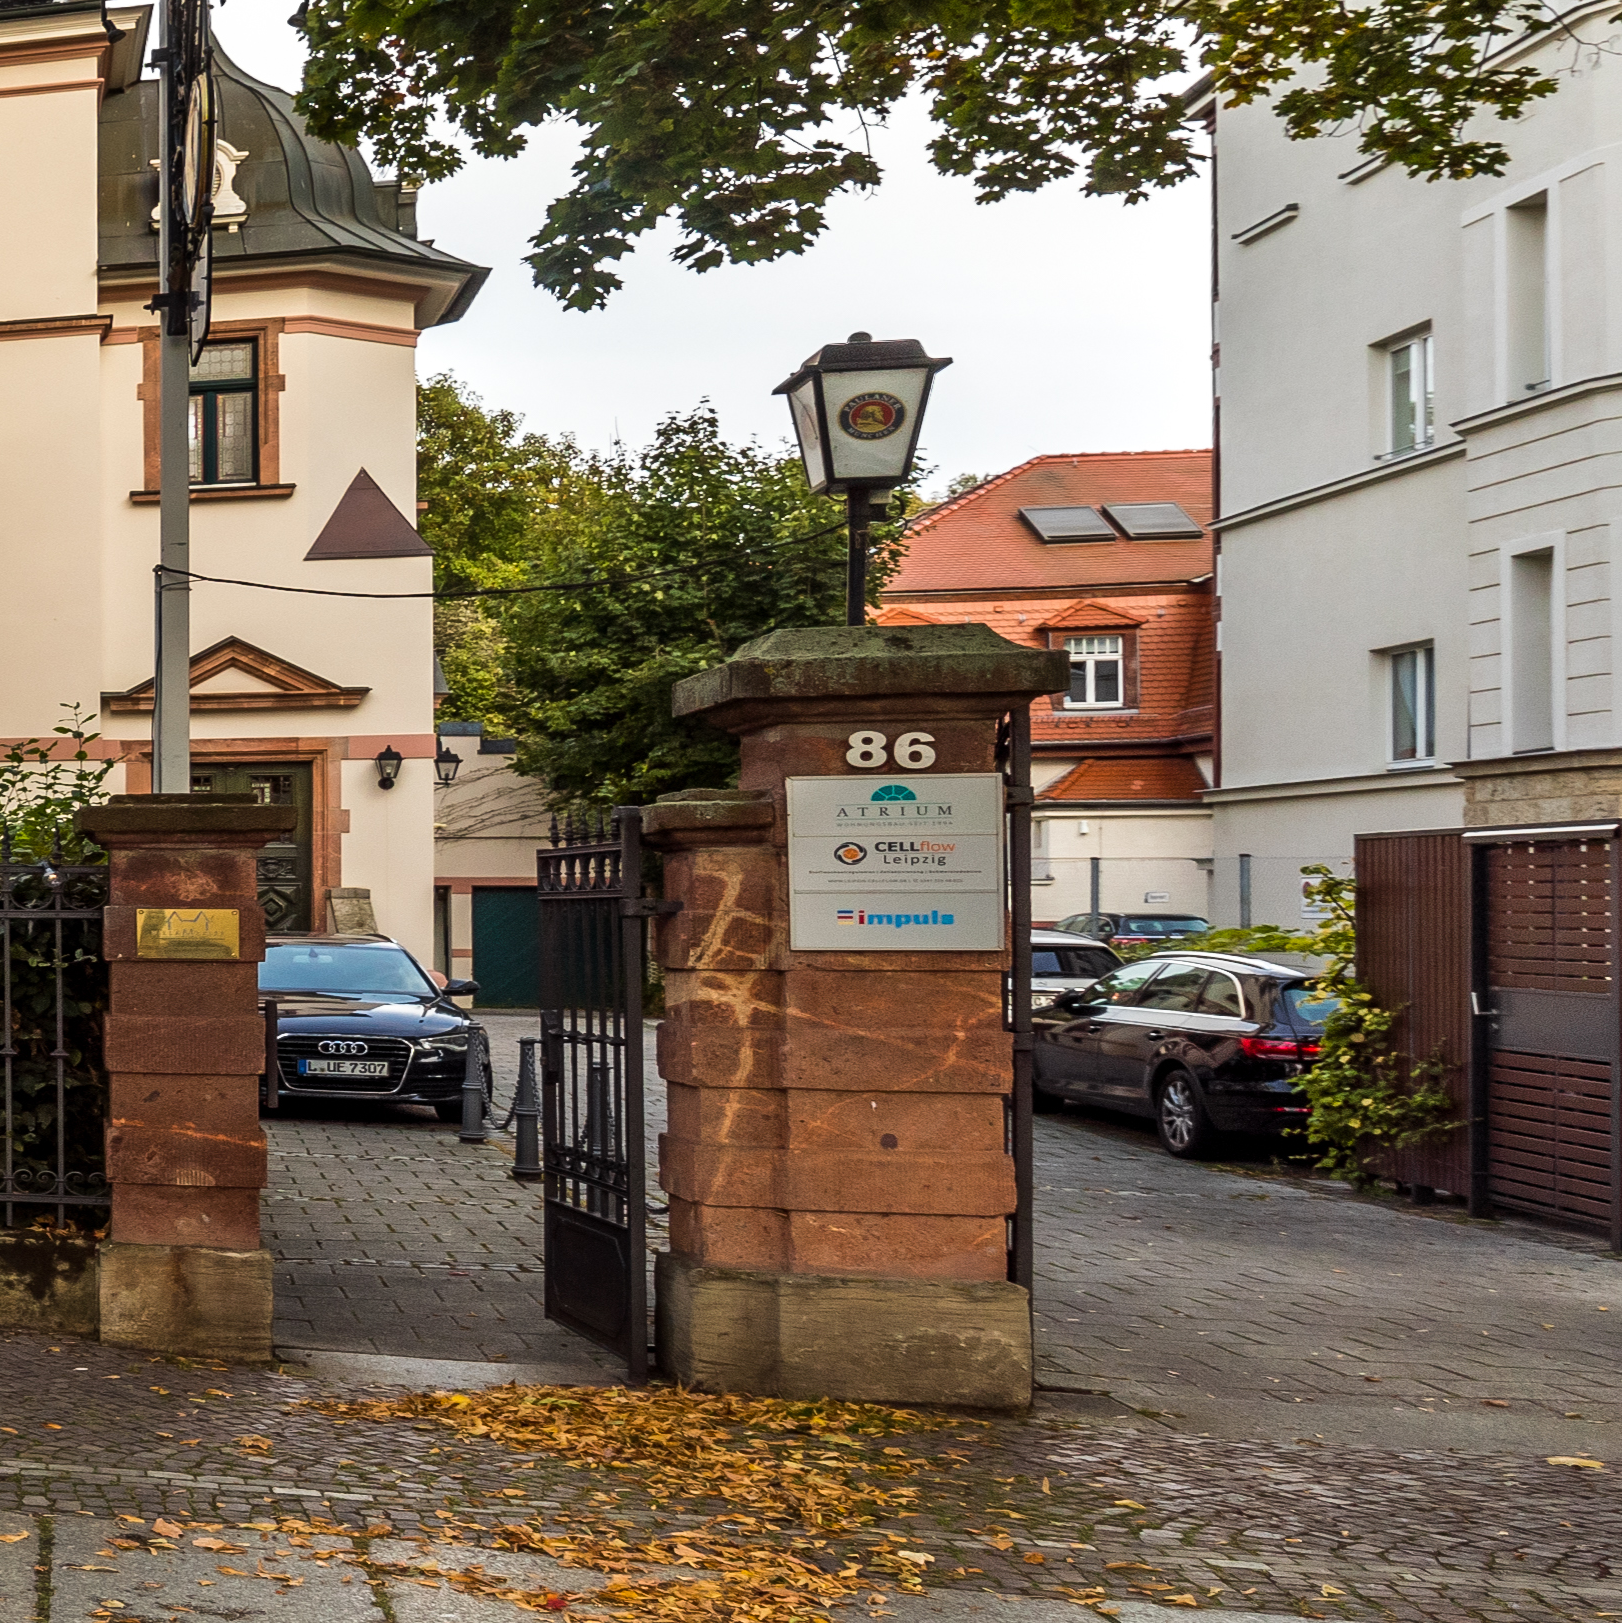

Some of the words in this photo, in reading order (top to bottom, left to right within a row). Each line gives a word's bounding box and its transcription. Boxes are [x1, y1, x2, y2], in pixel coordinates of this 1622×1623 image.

[845, 730, 937, 769] 86
[836, 806, 952, 817] ATRIUM
[874, 841, 956, 852] CELLflow
[884, 855, 946, 866] Leipzig
[858, 910, 954, 928] impuls
[308, 1060, 317, 1072] L
[326, 1061, 347, 1073] UE
[349, 1062, 386, 1074] 7307
